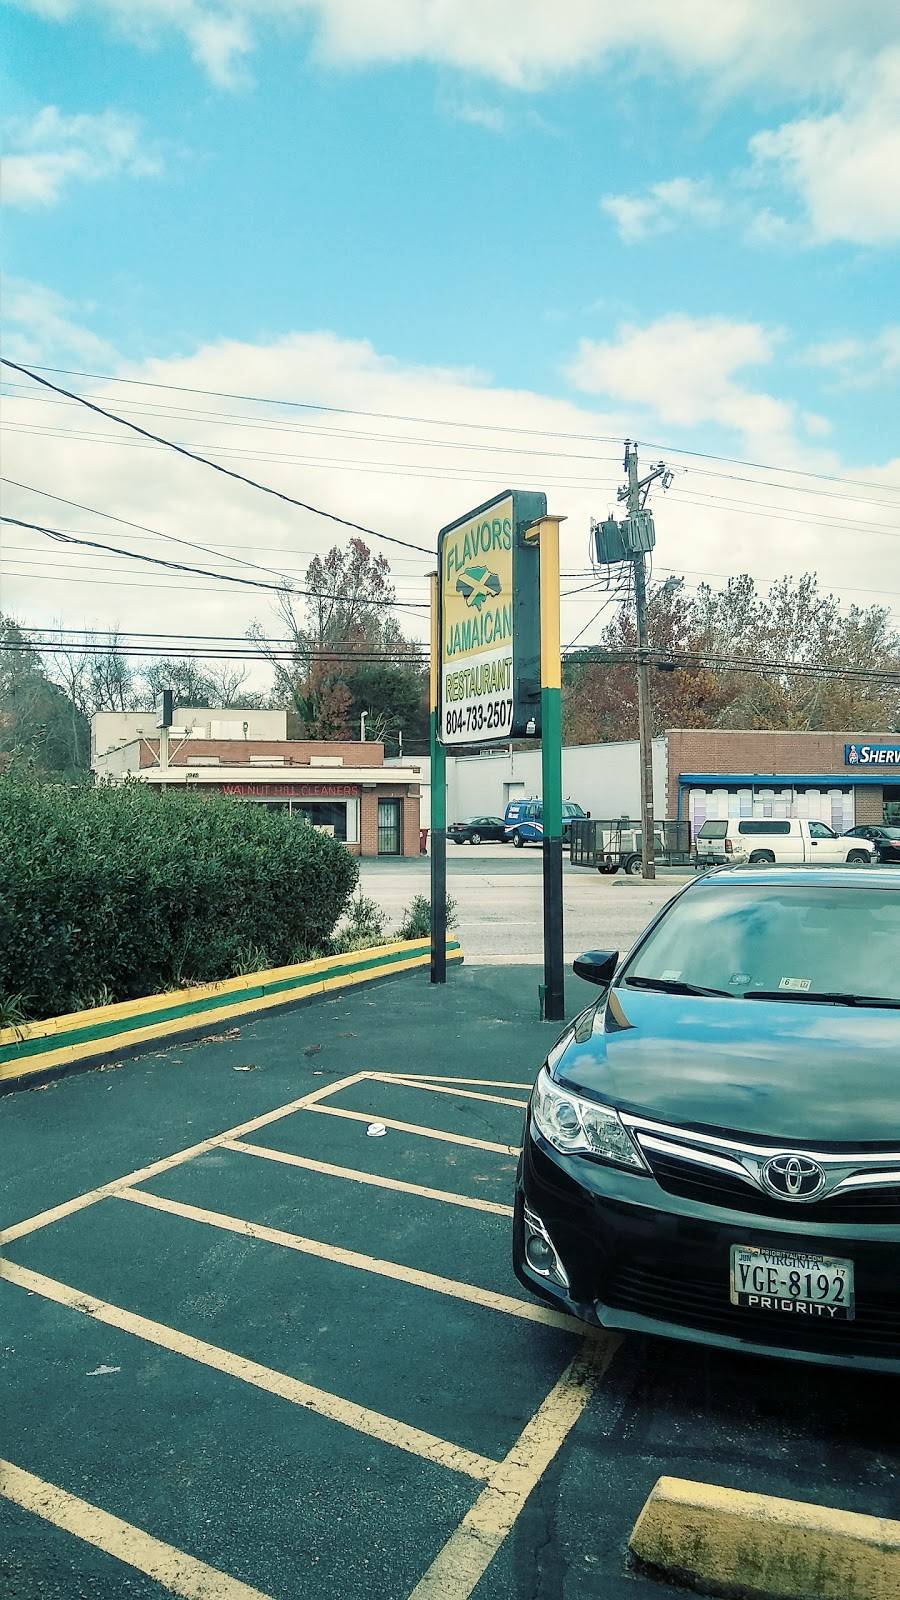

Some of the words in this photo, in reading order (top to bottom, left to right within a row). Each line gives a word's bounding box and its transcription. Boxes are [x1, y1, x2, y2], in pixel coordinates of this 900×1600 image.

[447, 518, 512, 580] FLAVORS
[446, 603, 512, 656] JAMAICAN
[446, 657, 512, 702] RESTAURANT
[446, 699, 513, 735] 804-733-2507
[223, 784, 271, 795] WALNUT
[301, 785, 358, 795] CLEANERS
[738, 1254, 752, 1263] JUN
[761, 1248, 823, 1263] PRIORITYAUTO.COM
[764, 1255, 821, 1271] VIRGINIA
[739, 1264, 845, 1302] VGE-8192
[836, 1269, 846, 1277] 17
[748, 1295, 837, 1318] PRIORITY
